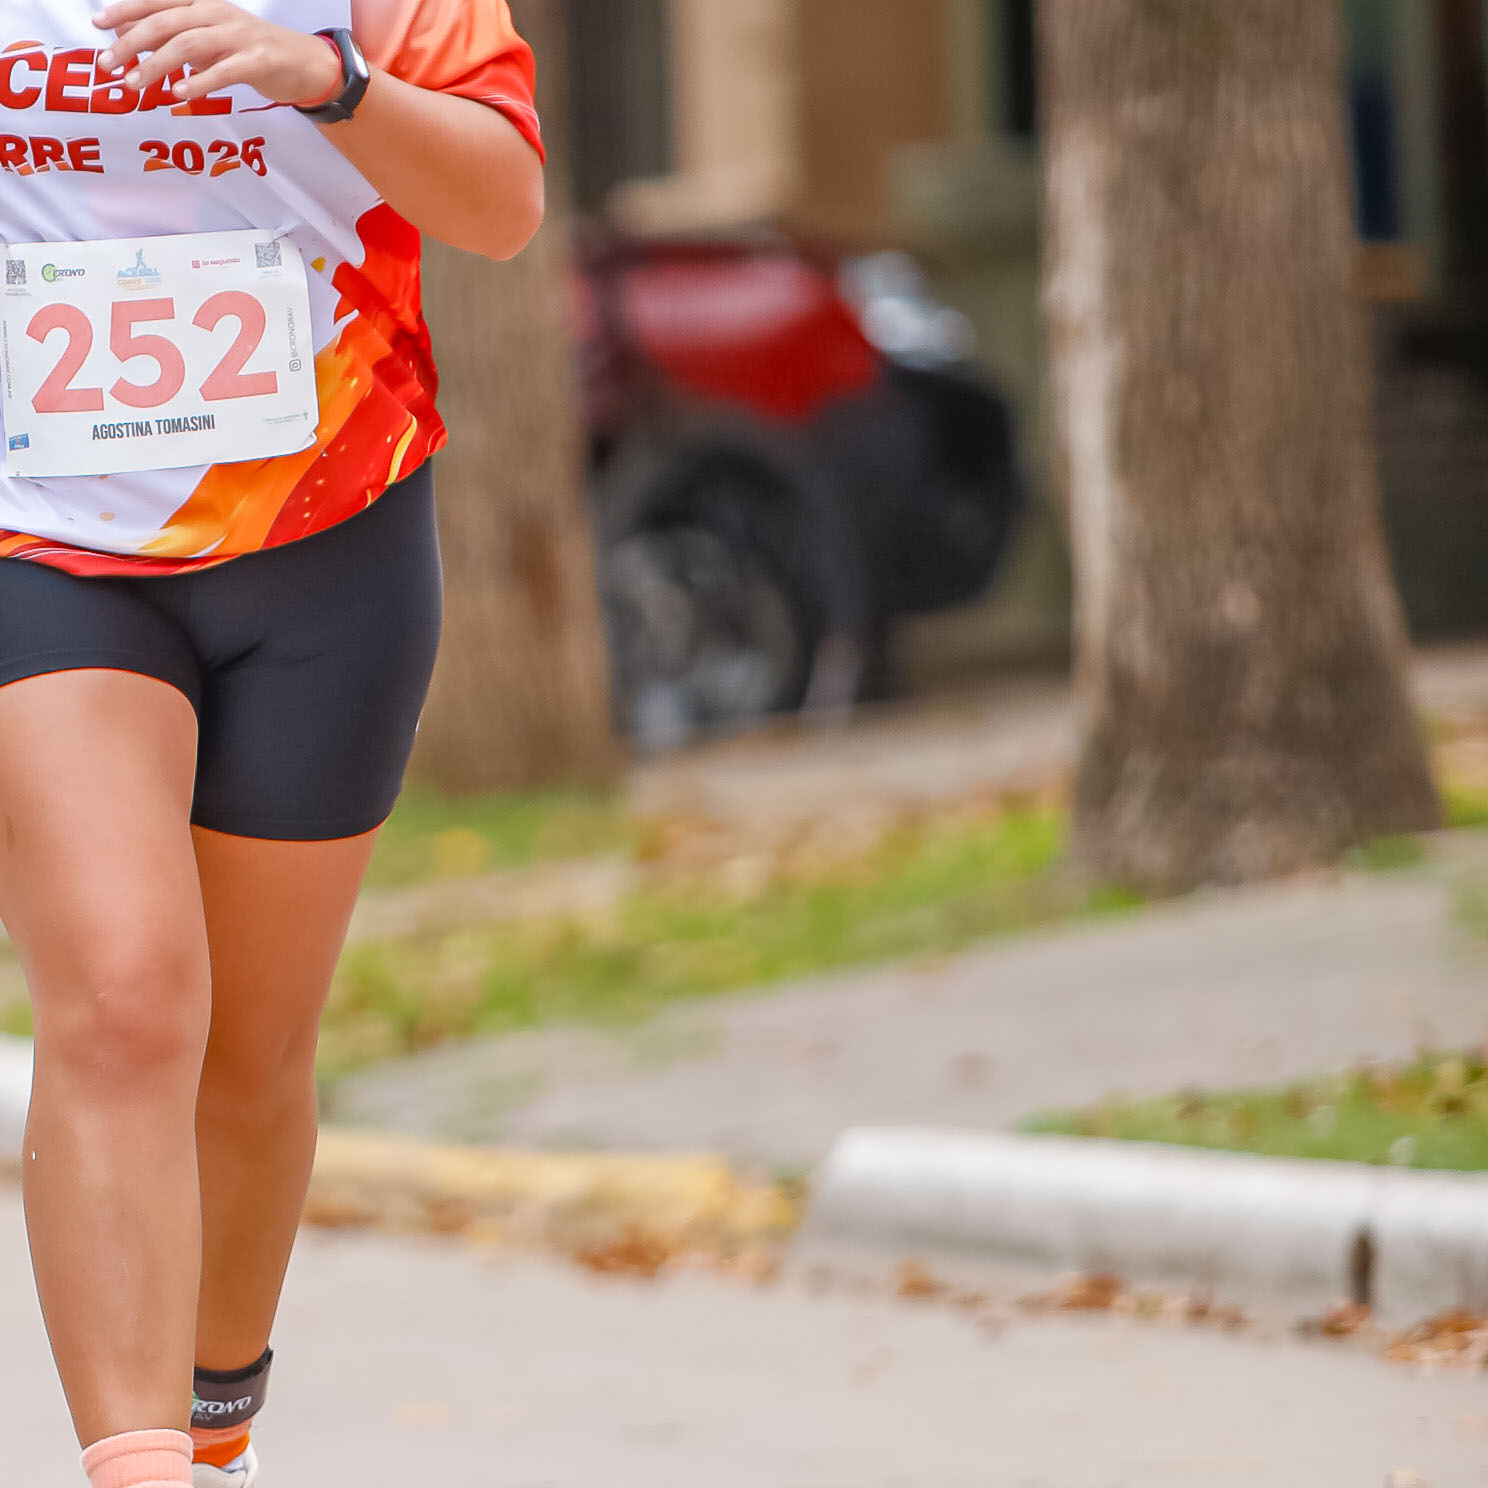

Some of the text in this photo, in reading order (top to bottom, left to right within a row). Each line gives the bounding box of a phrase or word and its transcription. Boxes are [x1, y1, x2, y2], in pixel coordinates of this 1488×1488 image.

[139, 136, 268, 177] 2026
[25, 290, 278, 413] 252
[92, 414, 216, 440] AGOSTINA TOMASINI
[192, 1396, 252, 1414] RONO
